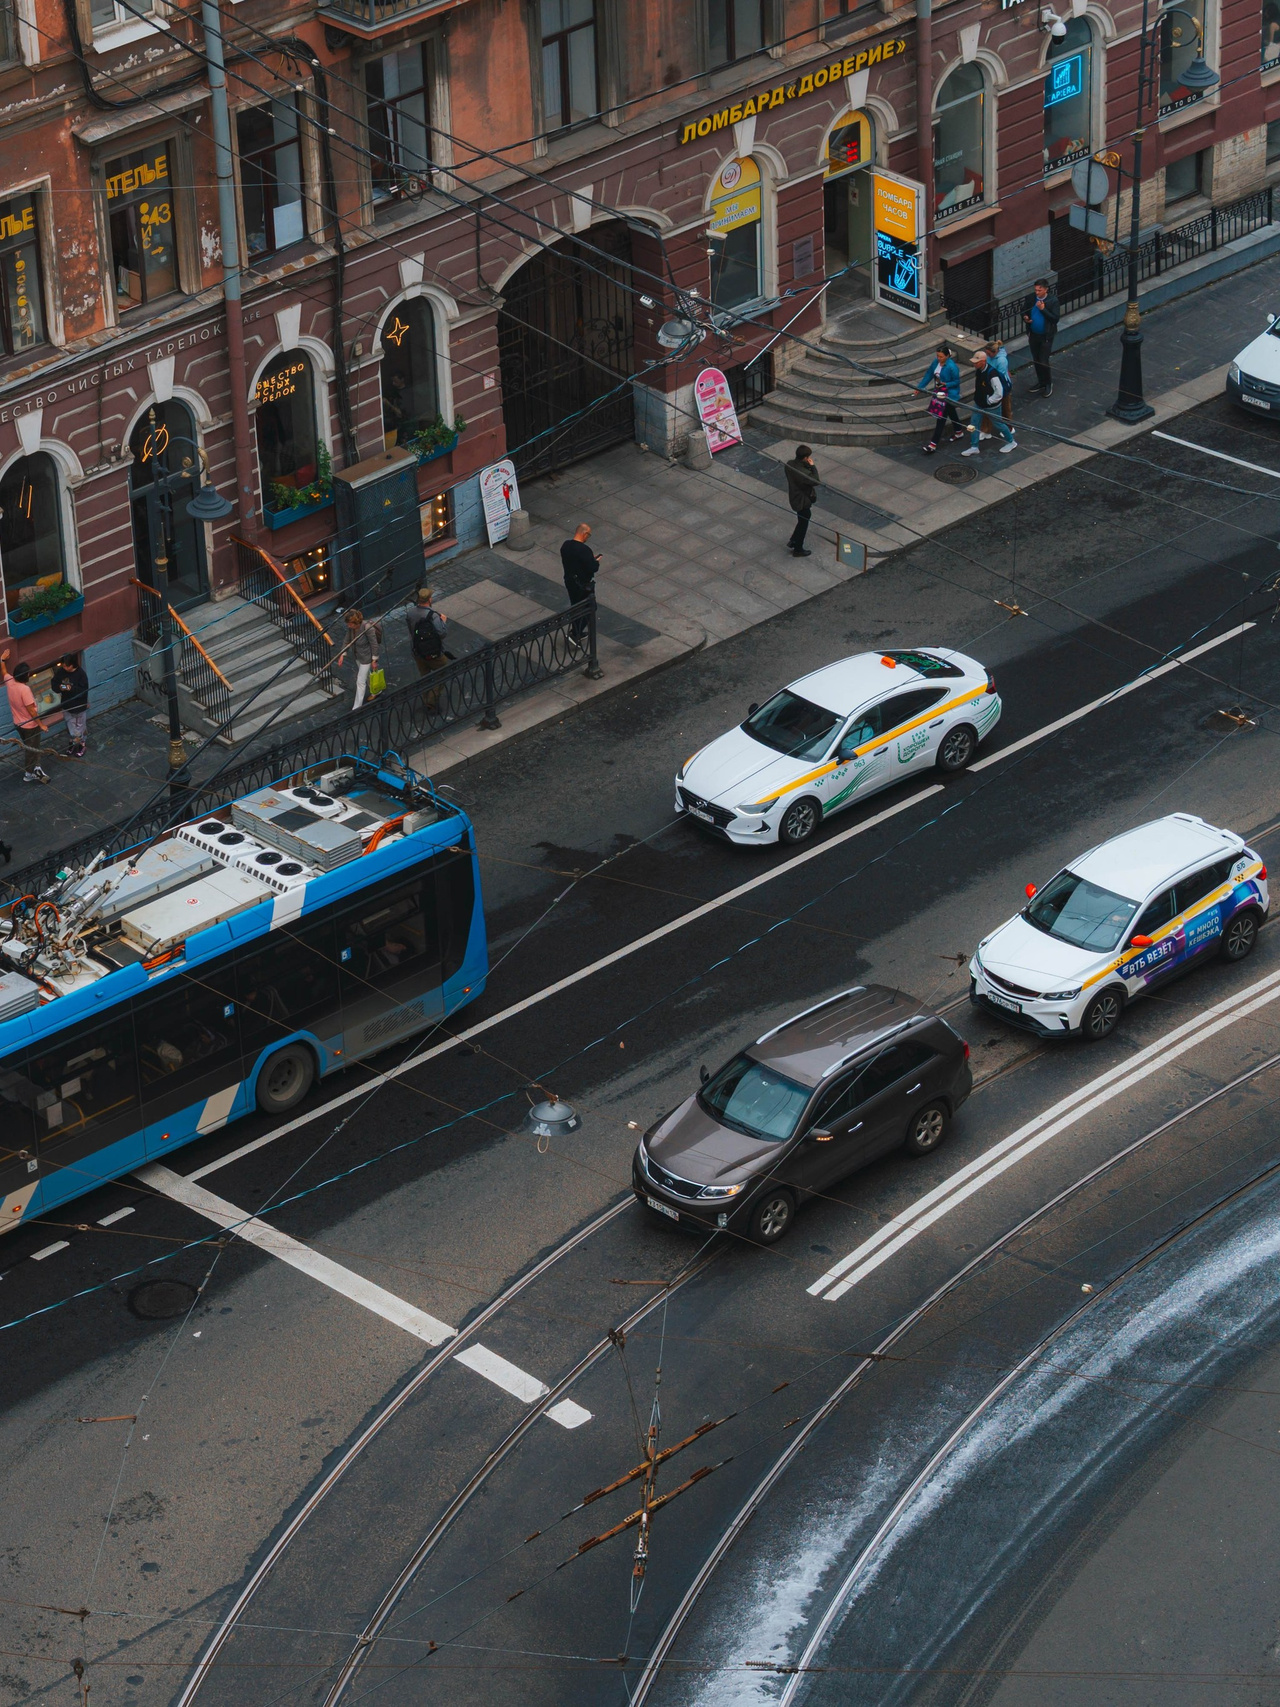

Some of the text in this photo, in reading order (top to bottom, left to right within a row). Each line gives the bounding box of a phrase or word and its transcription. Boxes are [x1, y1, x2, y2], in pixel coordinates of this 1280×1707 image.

[681, 86, 785, 144] ЛОМБАРД
[1044, 147, 1089, 172] EA STATION
[877, 188, 913, 210] ЛОМБАРД
[966, 196, 981, 206] TEA
[882, 203, 908, 220] ЧАСОВ
[242, 310, 262, 324] AFE
[67, 360, 135, 394] ЧИСТЫХ
[145, 324, 222, 363] ТАРЕЛОК
[256, 363, 305, 390] БЩЕСТВО
[254, 378, 290, 400] ИСТЫХ
[262, 385, 296, 404] РЕЛОК
[903, 736, 930, 752] ХОРОШЕЙ
[903, 743, 926, 758] ДОРОГИ
[853, 759, 866, 770] 963
[1197, 916, 1219, 934] МНОГО
[1188, 925, 1220, 947] КЕШБЭКА
[1129, 941, 1173, 975] ВТБ ВЕЗЁТ
